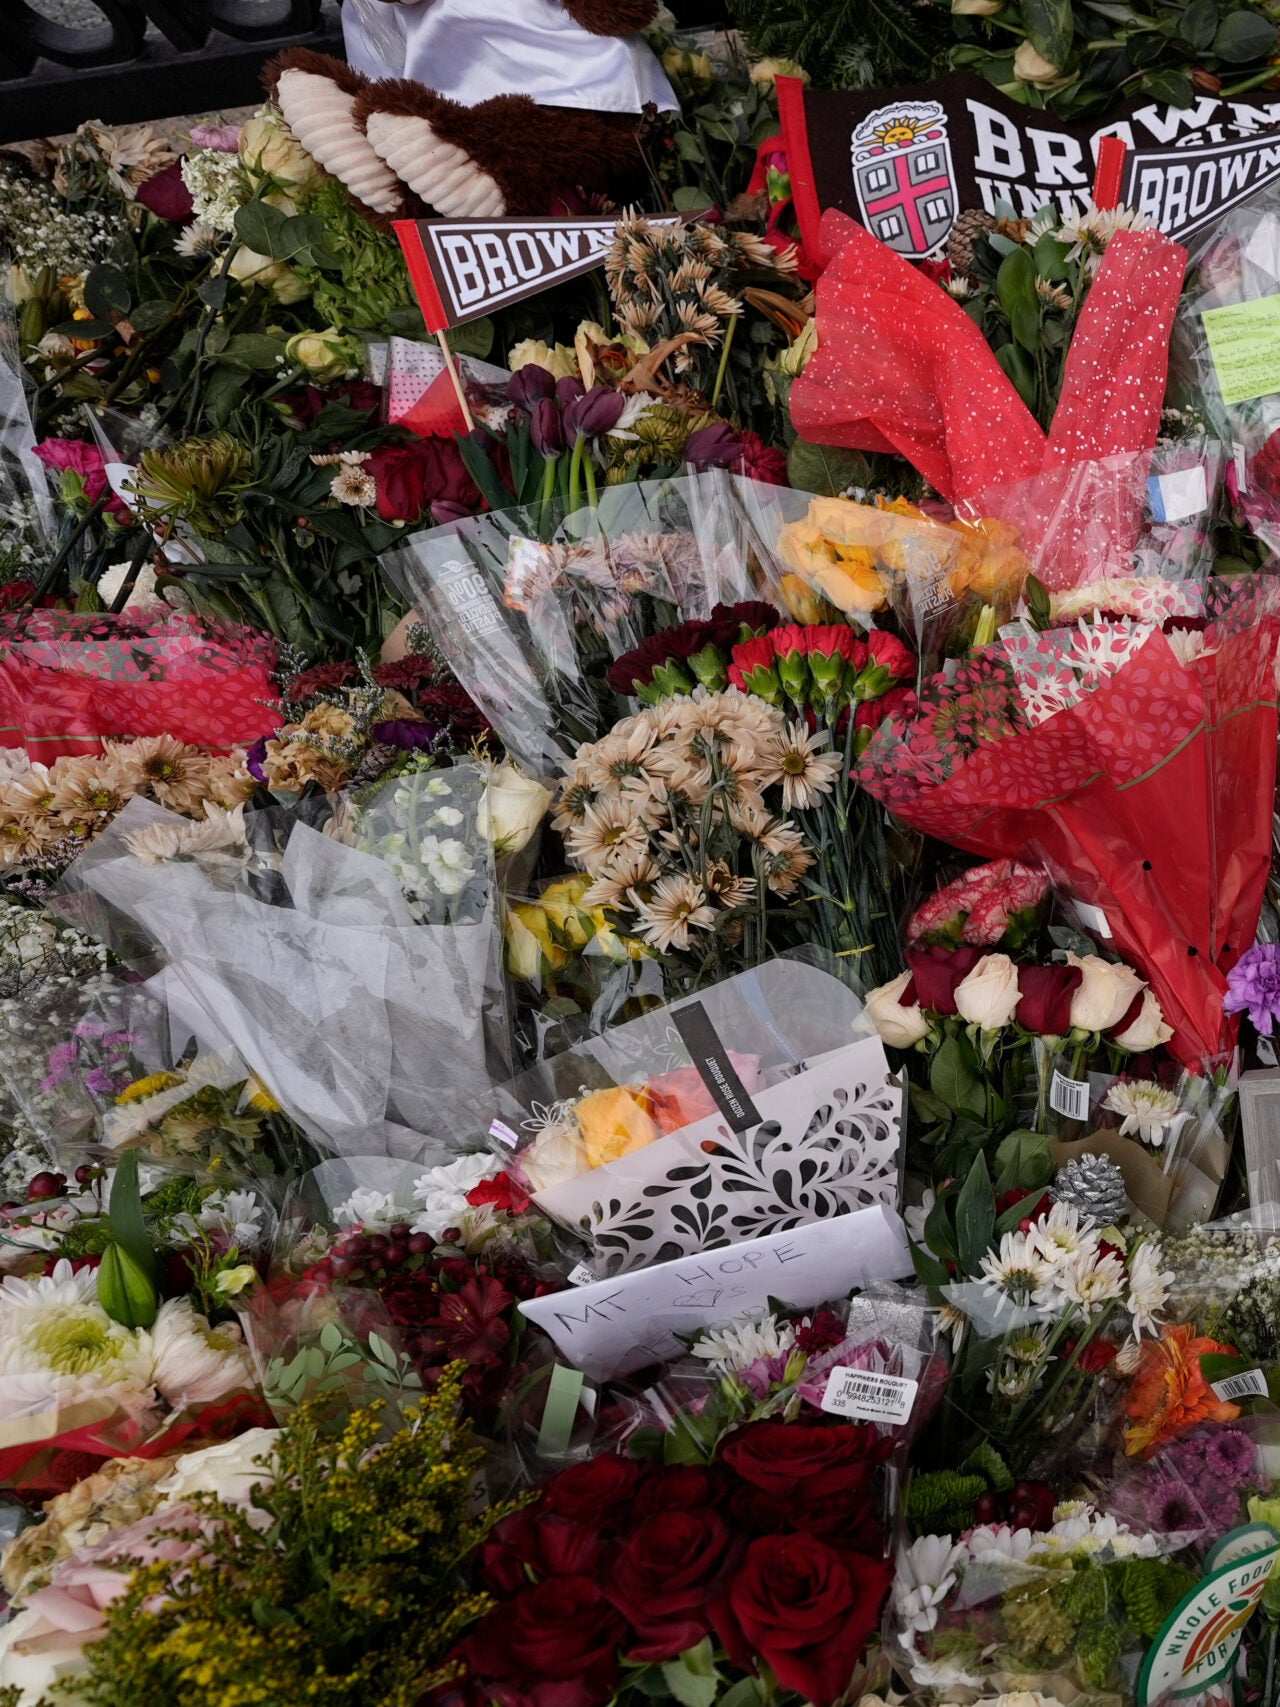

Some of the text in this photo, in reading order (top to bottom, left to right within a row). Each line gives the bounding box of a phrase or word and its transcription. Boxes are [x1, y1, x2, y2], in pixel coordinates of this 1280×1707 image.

[439, 228, 617, 306] BROWN
[704, 1056, 746, 1119] DOZEN ROSE BOUQUET
[553, 1289, 627, 1334] MT
[674, 1240, 808, 1286] HOPE
[831, 1398, 846, 1408] 335
[845, 1372, 908, 1389] HAPPINESS BOUQUET
[1165, 1592, 1222, 1657] WHOLE
[1196, 1643, 1228, 1673] FOR
